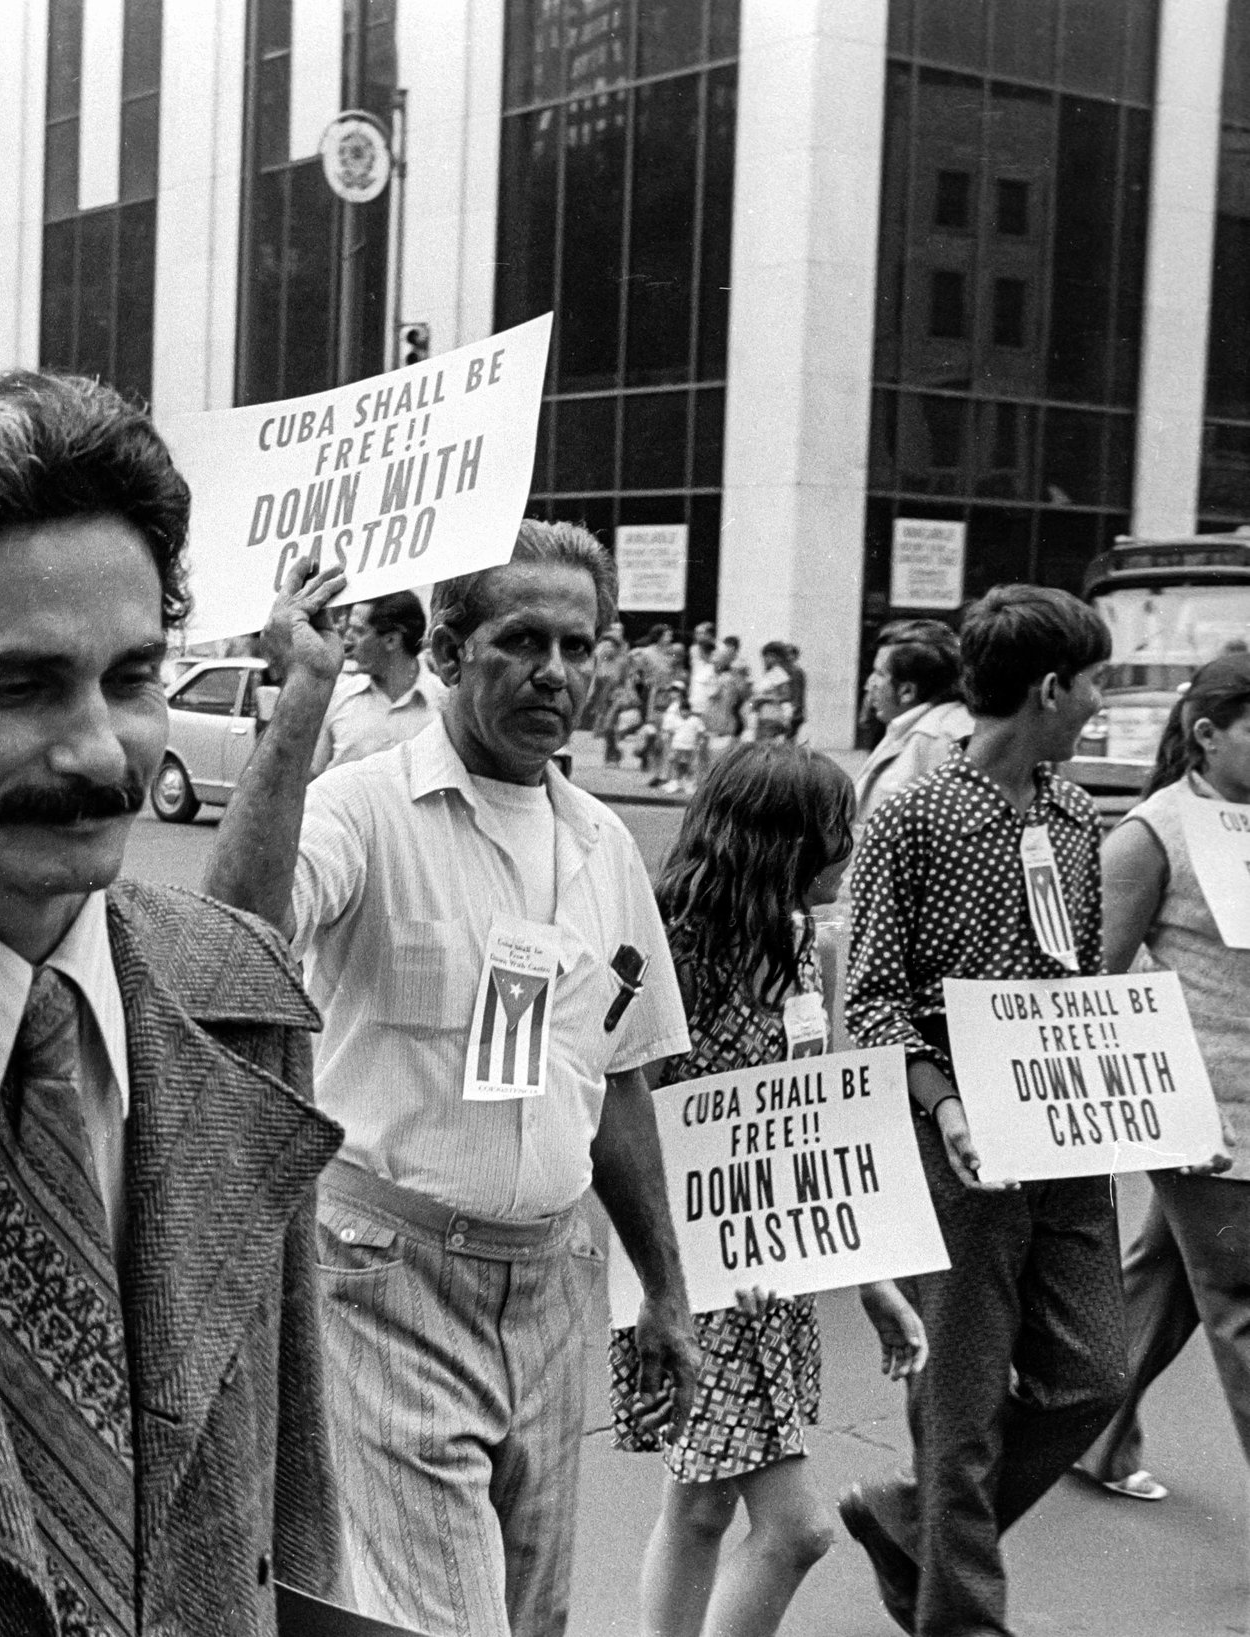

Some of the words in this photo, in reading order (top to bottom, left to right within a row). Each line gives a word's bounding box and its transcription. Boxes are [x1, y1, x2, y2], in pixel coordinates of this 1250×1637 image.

[258, 405, 334, 451] CUBA
[354, 370, 445, 428] SHALL
[465, 348, 505, 394] BE
[314, 412, 431, 476] FREE!!
[247, 471, 361, 547] DOWN
[379, 434, 484, 516] WITH
[991, 992, 1043, 1021] CUBA
[1050, 989, 1119, 1018] SHALL
[1127, 987, 1158, 1014] BE
[1038, 1021, 1120, 1052] FREE!!
[683, 1086, 741, 1127] CUBA
[755, 1071, 827, 1114] SHALL
[841, 1065, 871, 1100] BE
[1011, 1055, 1089, 1102] DOWN
[1097, 1051, 1176, 1097] WITH
[731, 1111, 821, 1158] FREE!!
[1046, 1098, 1161, 1147] CASTRO
[686, 1157, 775, 1222] DOWN
[793, 1142, 879, 1204] WITH
[719, 1201, 861, 1270] CASTRO
